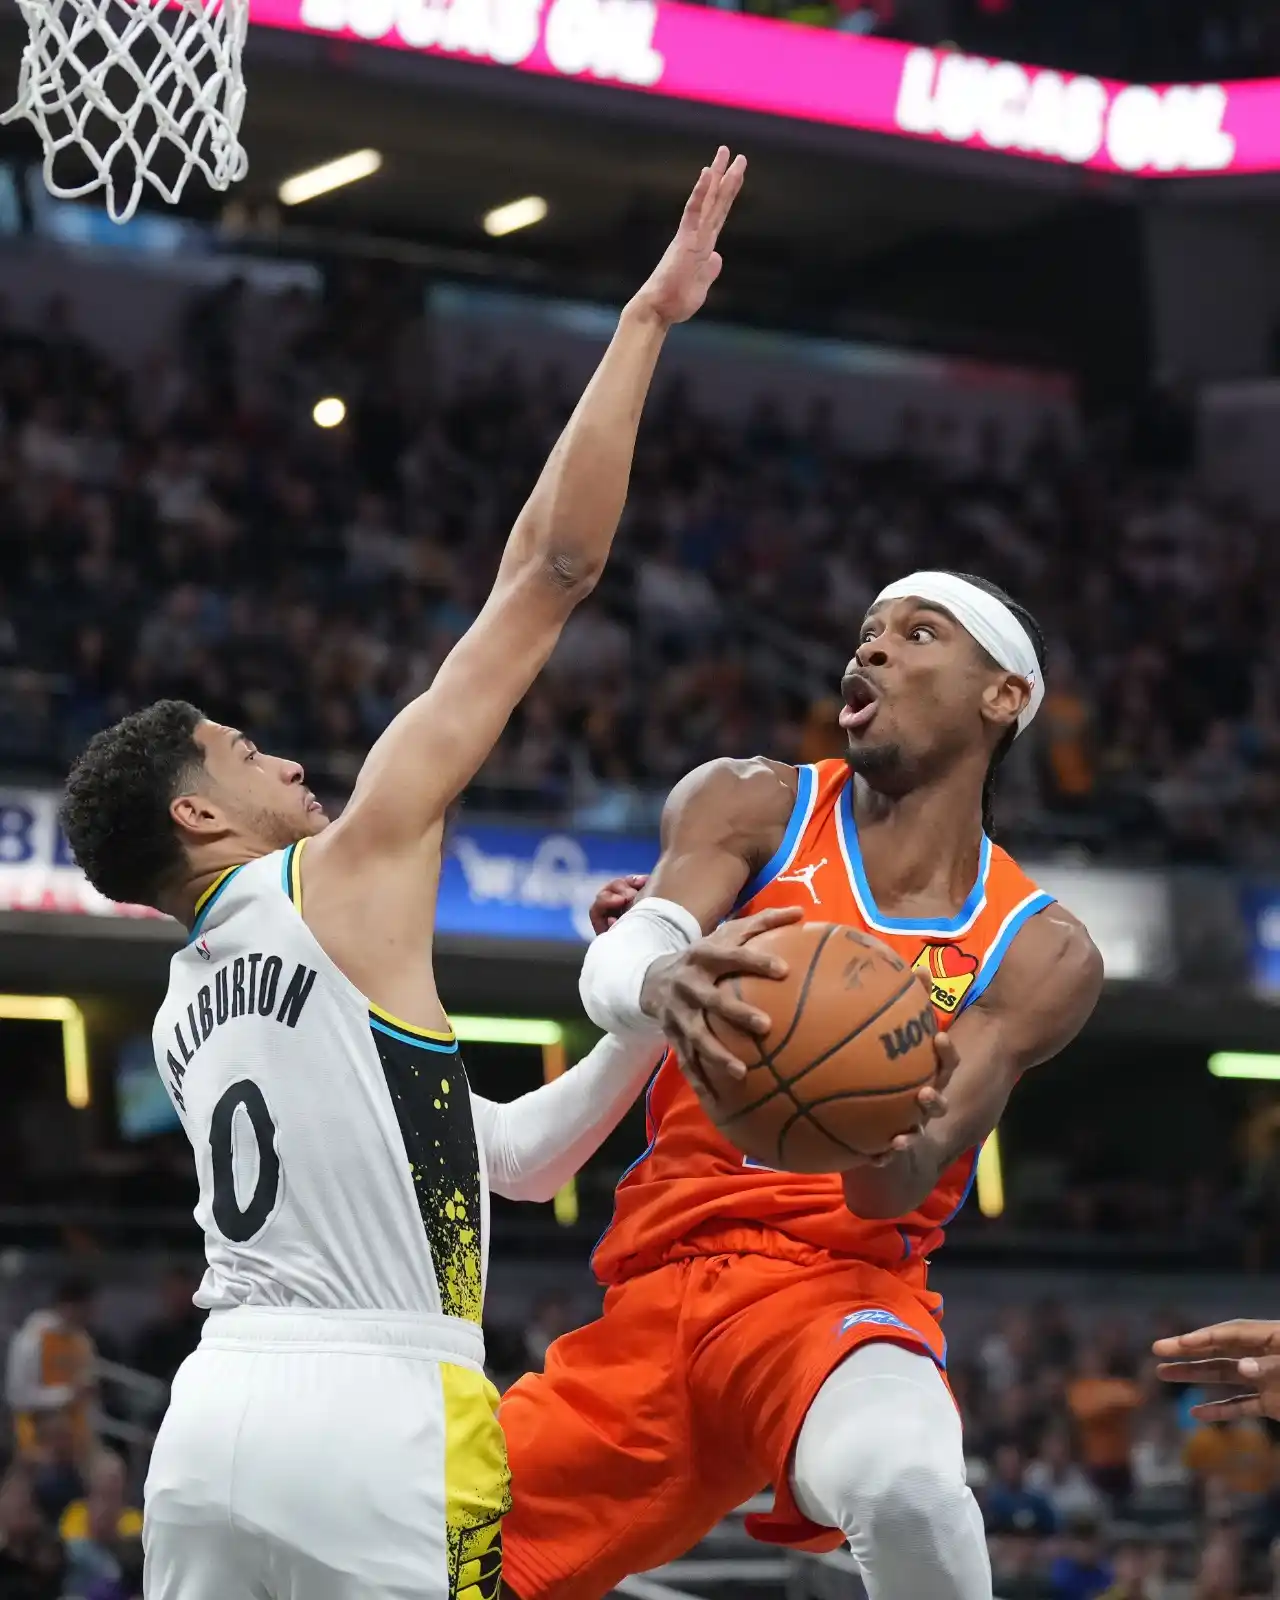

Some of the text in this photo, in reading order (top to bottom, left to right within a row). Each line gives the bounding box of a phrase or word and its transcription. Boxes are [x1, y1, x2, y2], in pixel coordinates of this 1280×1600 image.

[896, 48, 1234, 171] LUCAS OIL
[167, 952, 317, 1116] HALIBURTON
[208, 1078, 280, 1243] 0
